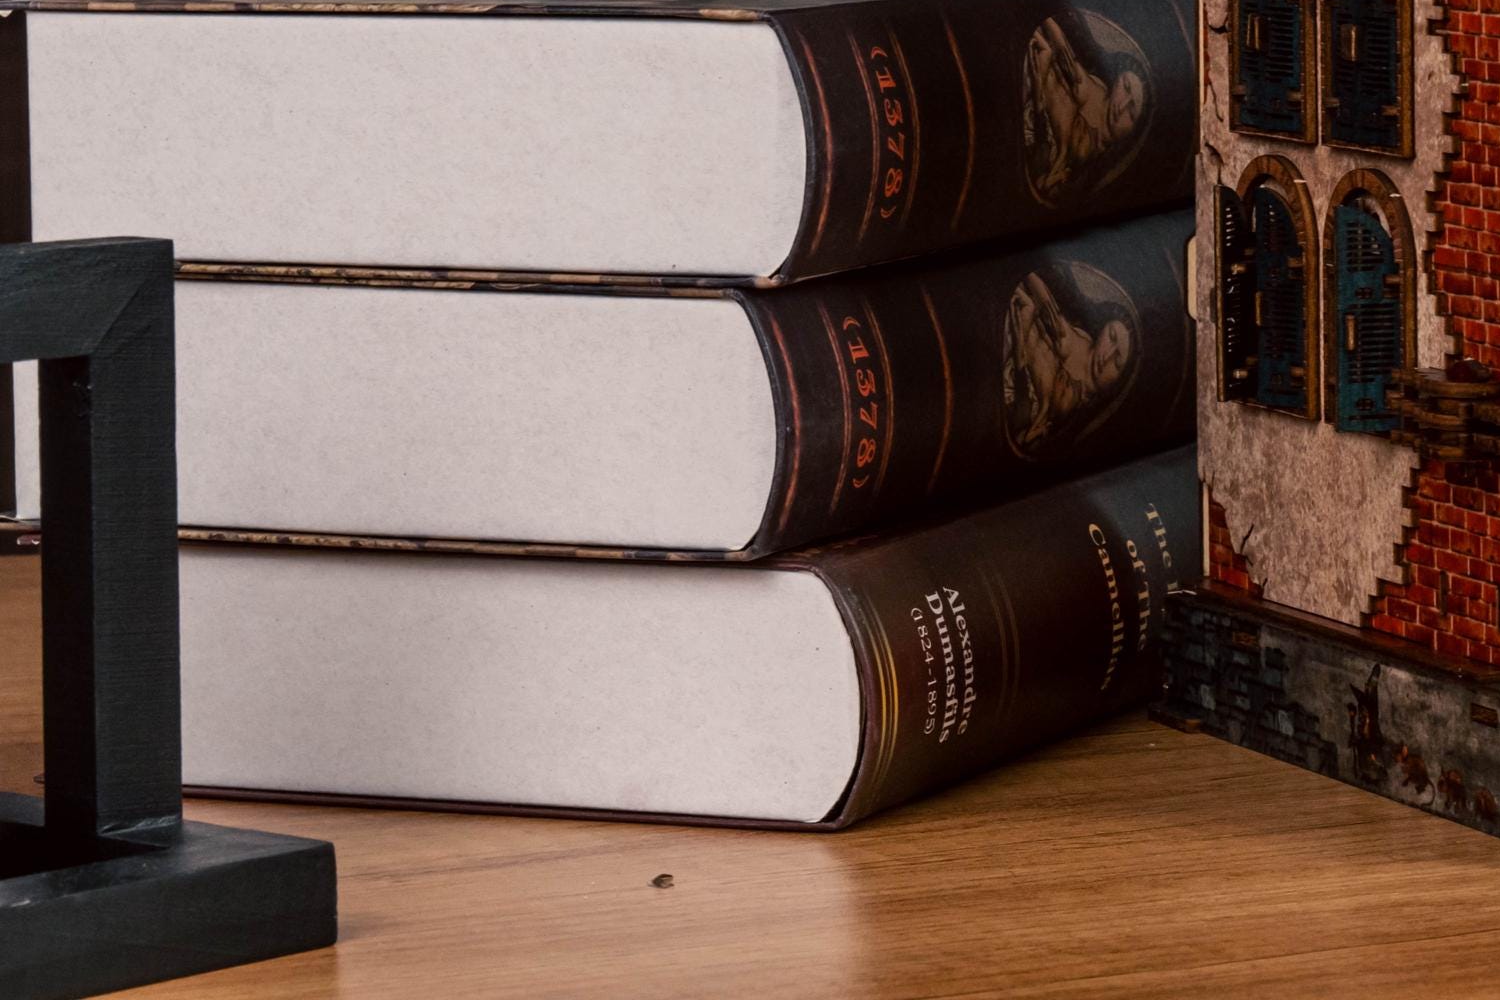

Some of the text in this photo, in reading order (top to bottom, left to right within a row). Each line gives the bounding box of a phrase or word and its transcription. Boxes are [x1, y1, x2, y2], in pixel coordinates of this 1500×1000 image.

[869, 45, 906, 219] (1378)
[843, 315, 879, 489] (1378)
[1126, 539, 1147, 577] of
[1145, 503, 1173, 570] The
[942, 586, 977, 736] Alexandre
